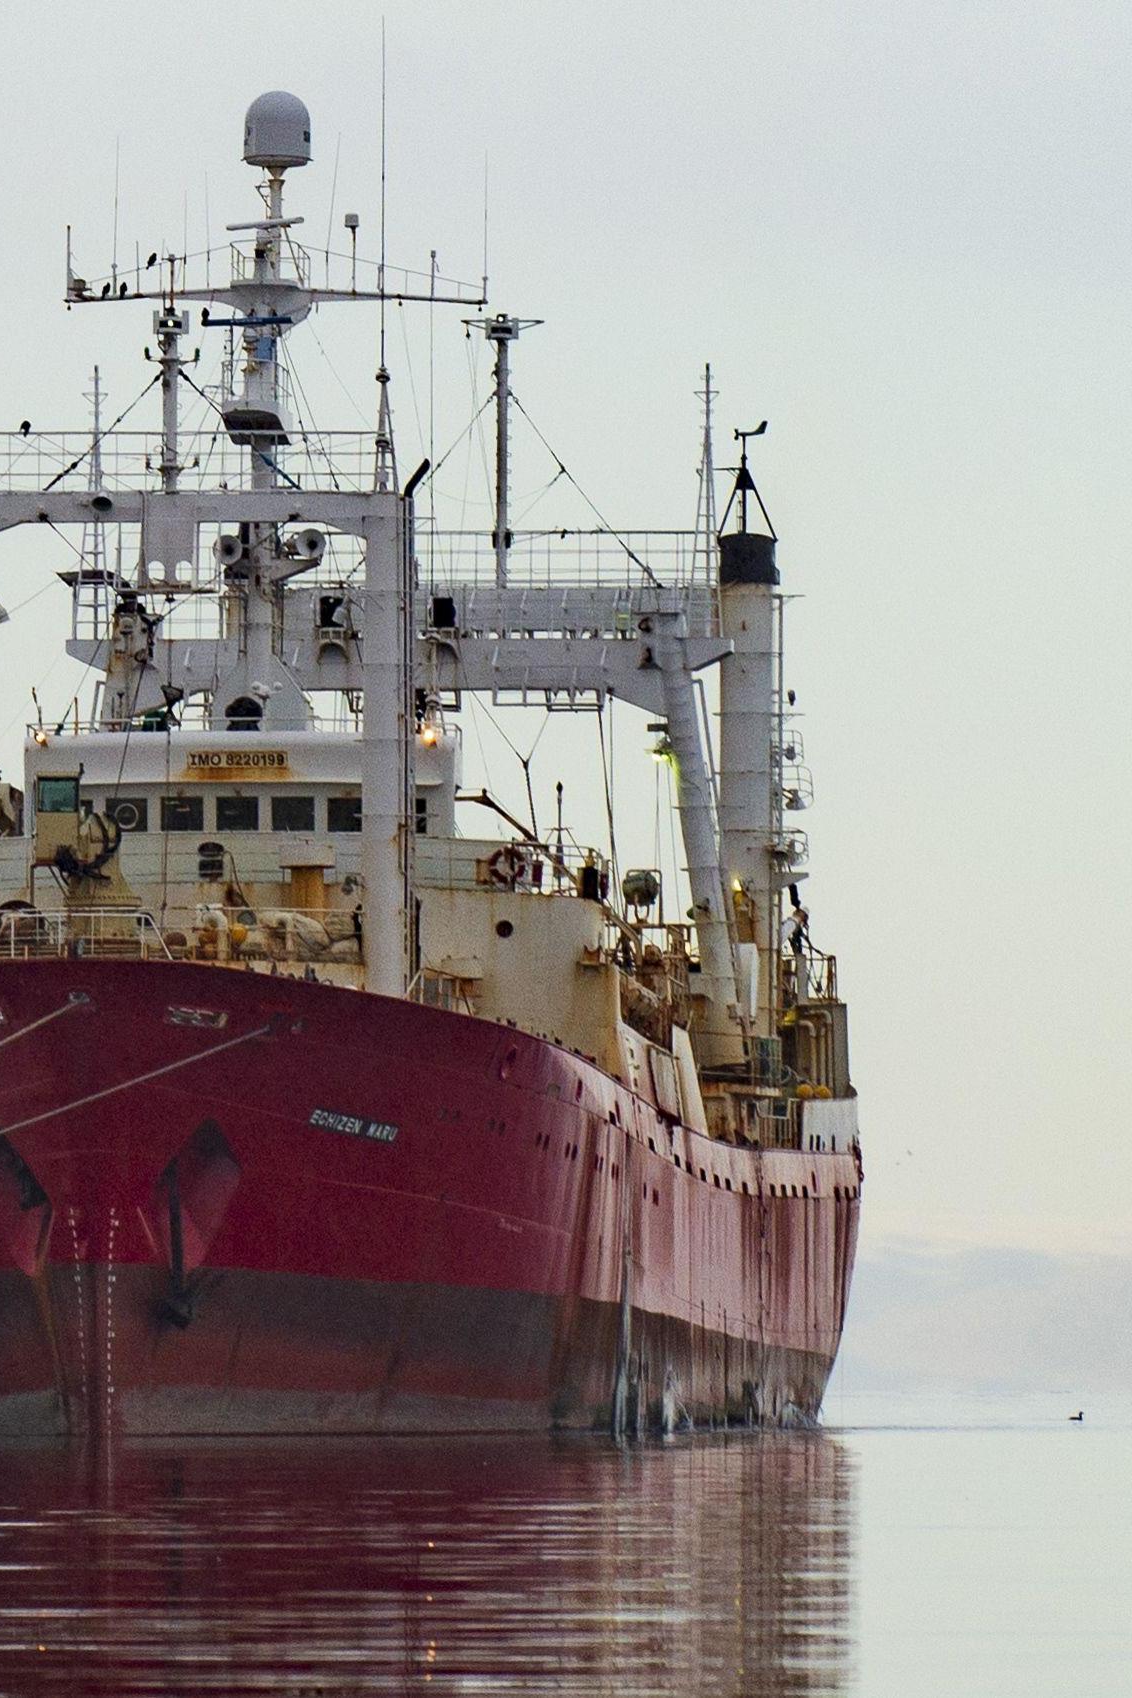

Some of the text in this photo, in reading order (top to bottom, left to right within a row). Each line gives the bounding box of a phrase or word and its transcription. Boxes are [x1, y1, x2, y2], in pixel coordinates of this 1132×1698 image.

[190, 754, 284, 766] IMO 8220199
[309, 1109, 398, 1140] ECHIZEN MARU
